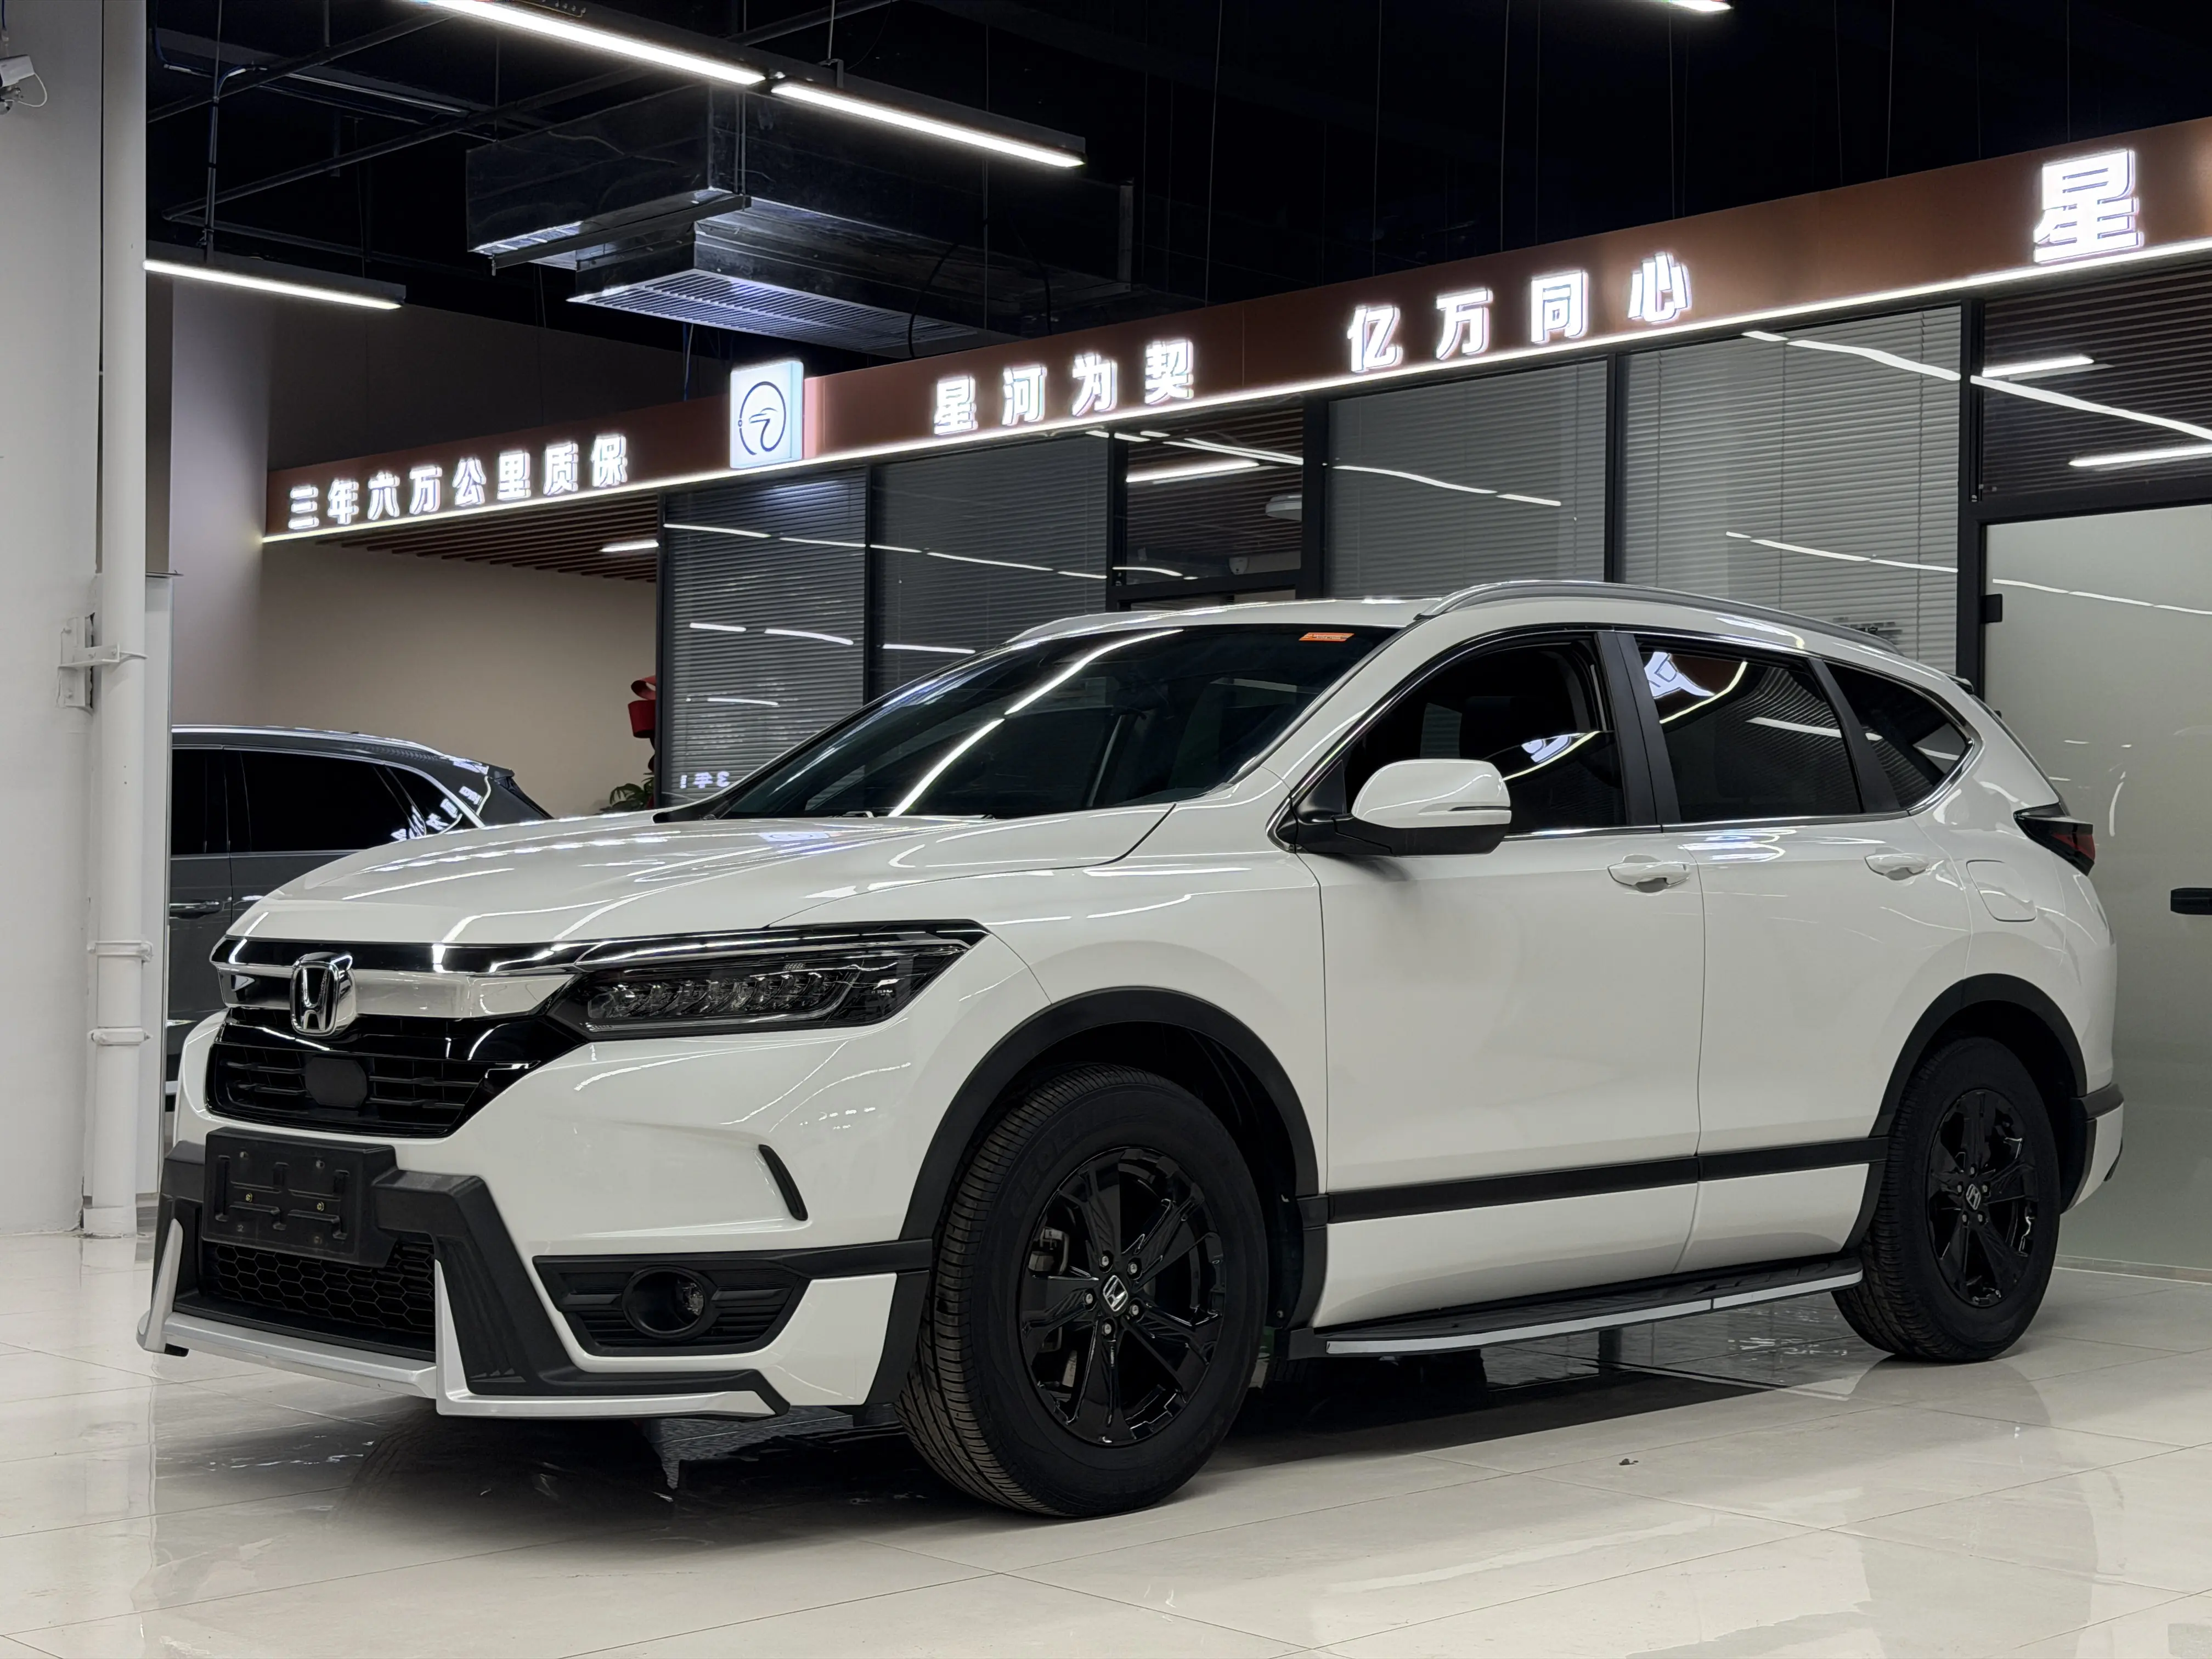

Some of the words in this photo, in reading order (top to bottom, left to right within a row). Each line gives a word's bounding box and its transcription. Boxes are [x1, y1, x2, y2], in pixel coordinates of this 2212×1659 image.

[2033, 149, 2144, 265] 星
[934, 339, 1194, 434] 星河为契
[1347, 251, 1692, 371] 亿万同心
[289, 434, 628, 529] 三年六万公里质保
